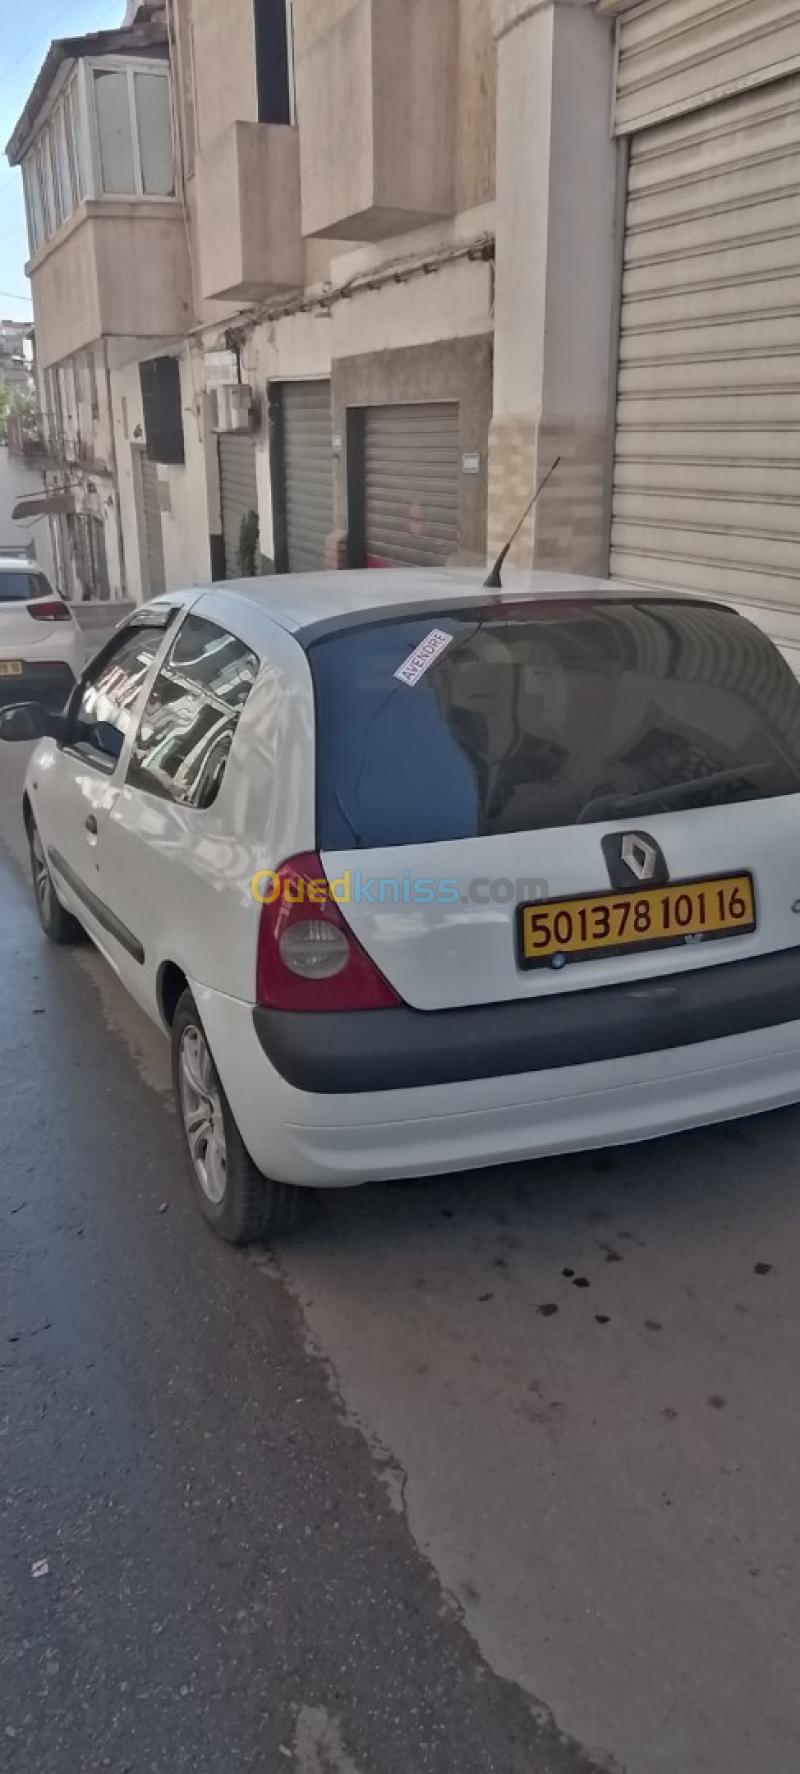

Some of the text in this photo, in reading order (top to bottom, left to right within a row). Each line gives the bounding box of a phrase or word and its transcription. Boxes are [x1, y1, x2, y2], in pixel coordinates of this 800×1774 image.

[531, 887, 746, 948] 501378 101 16
